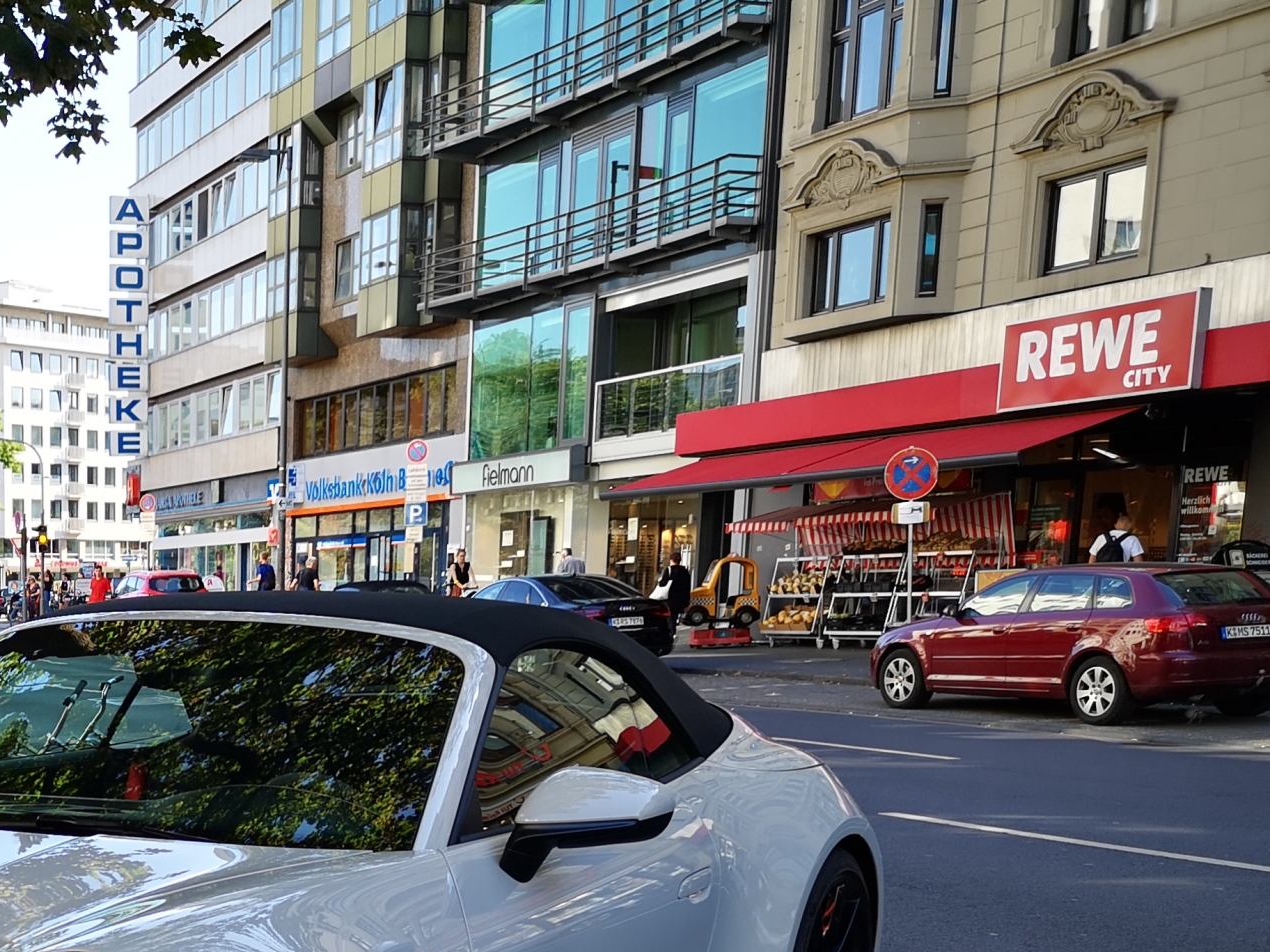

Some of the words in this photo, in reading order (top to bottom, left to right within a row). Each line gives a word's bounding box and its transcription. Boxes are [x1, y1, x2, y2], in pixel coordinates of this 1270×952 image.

[115, 198, 145, 454] APOTHEKE
[1016, 308, 1162, 383] REWE
[1122, 364, 1172, 388] CITY
[1184, 465, 1229, 484] REWE
[306, 472, 364, 501] Volksbank
[366, 468, 397, 495] Köln
[1180, 504, 1224, 516] willkommen
[1181, 495, 1211, 506] Herzlich
[409, 504, 423, 523] P
[1238, 627, 1250, 637] MS
